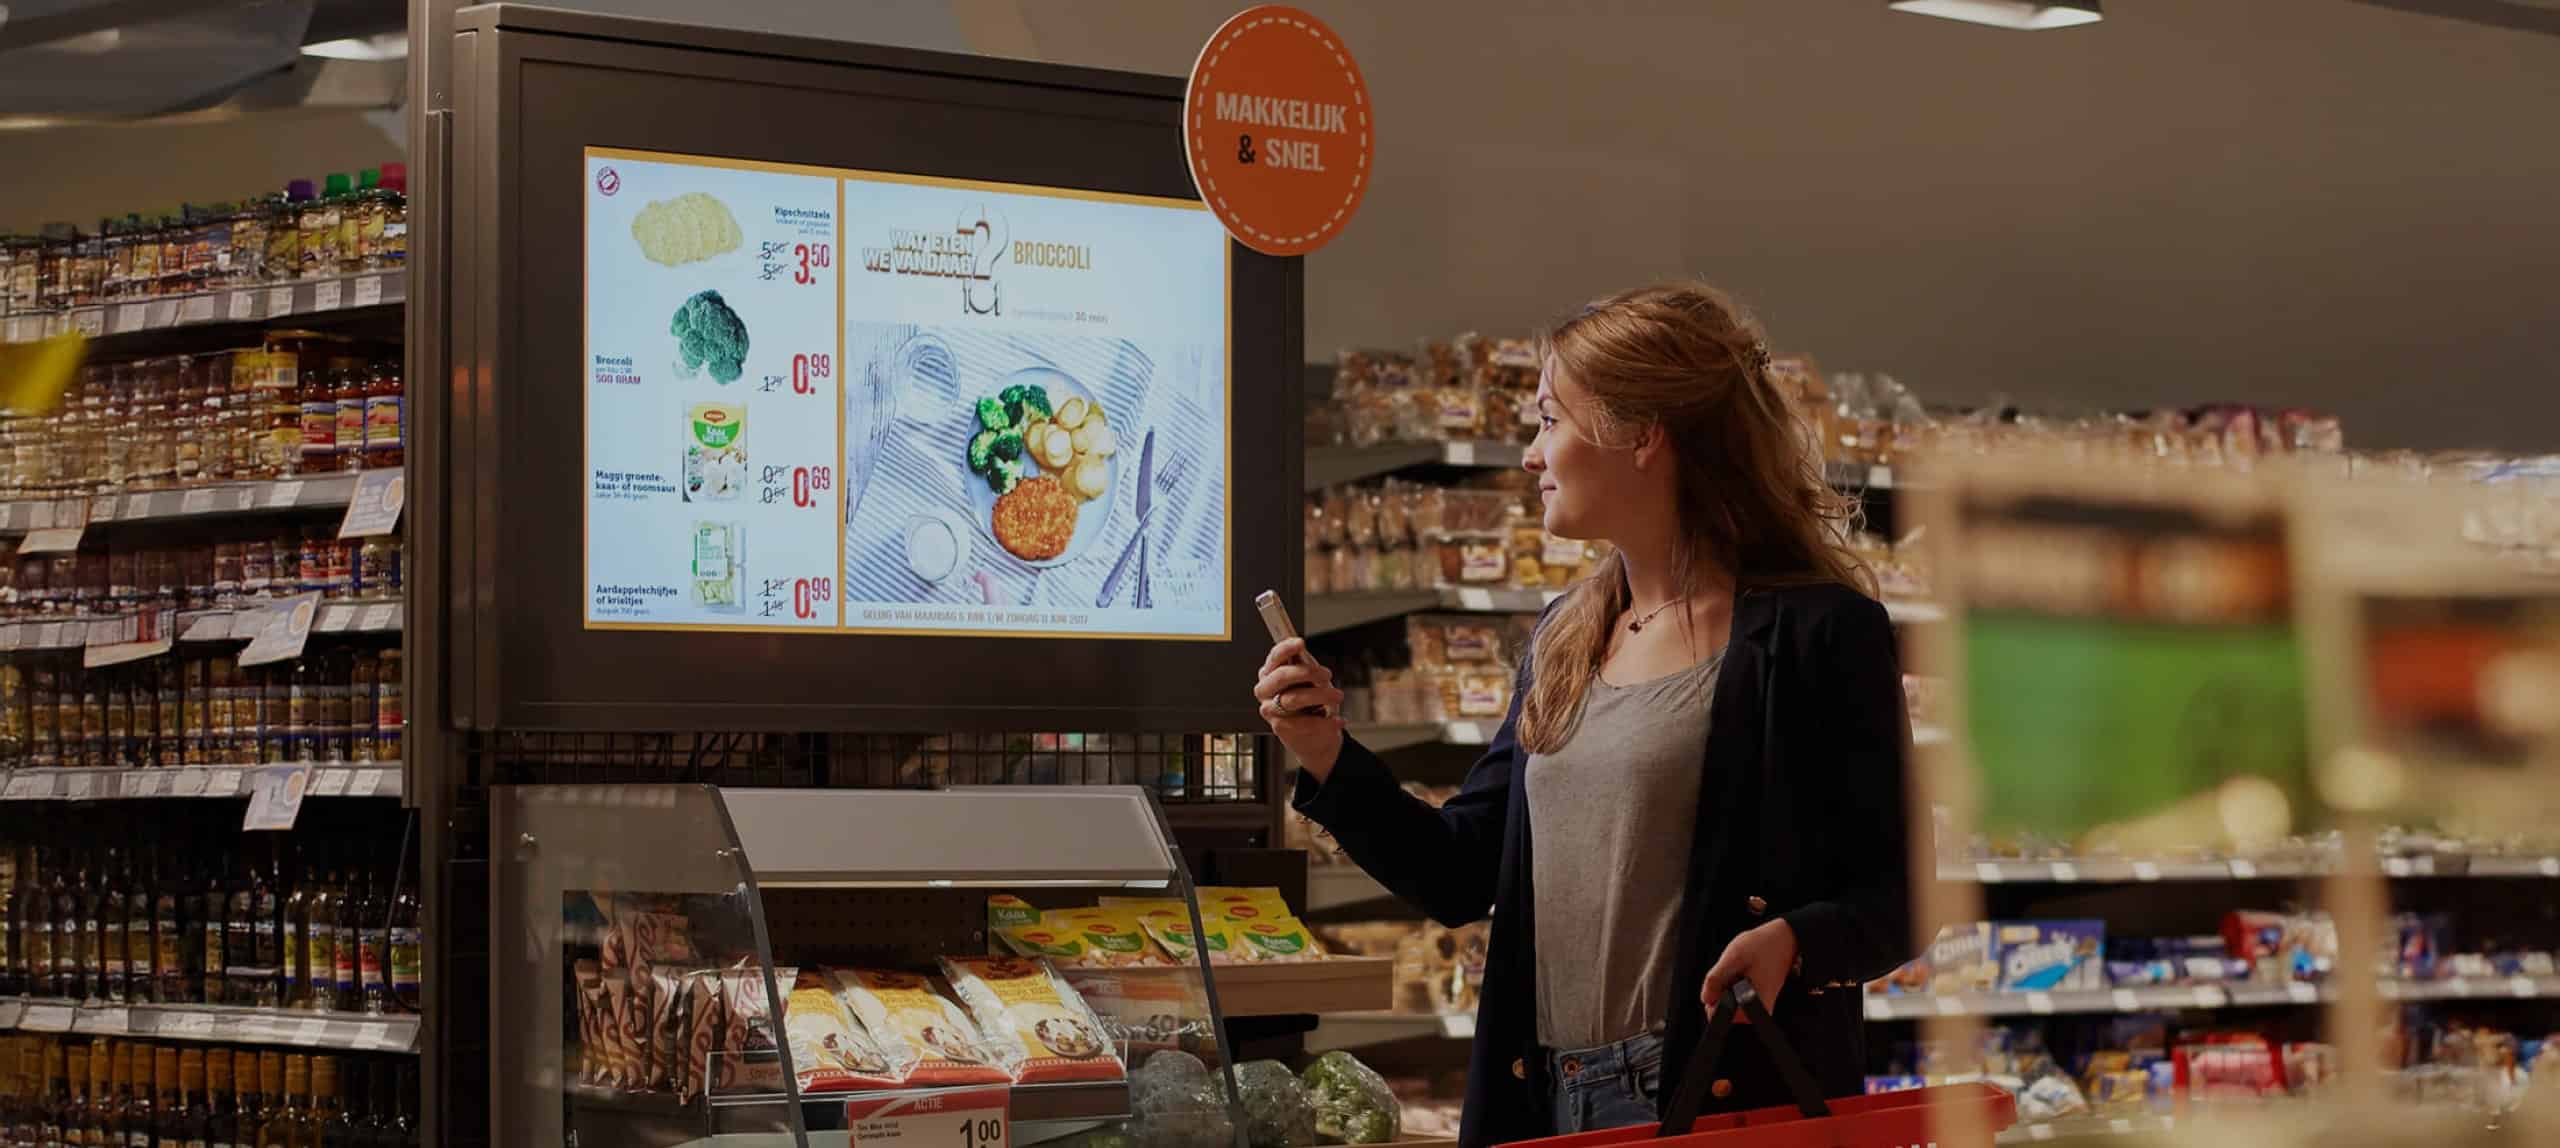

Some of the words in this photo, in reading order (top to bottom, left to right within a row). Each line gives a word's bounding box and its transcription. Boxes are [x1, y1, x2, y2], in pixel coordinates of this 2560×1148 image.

[1215, 92, 1347, 134] MAKKELIJK
[1238, 134, 1256, 164] &
[1265, 138, 1325, 171] SNEL
[1014, 240, 1091, 270] BROCCOLI
[596, 470, 624, 482] Maggi
[914, 1096, 943, 1112] ACTIE
